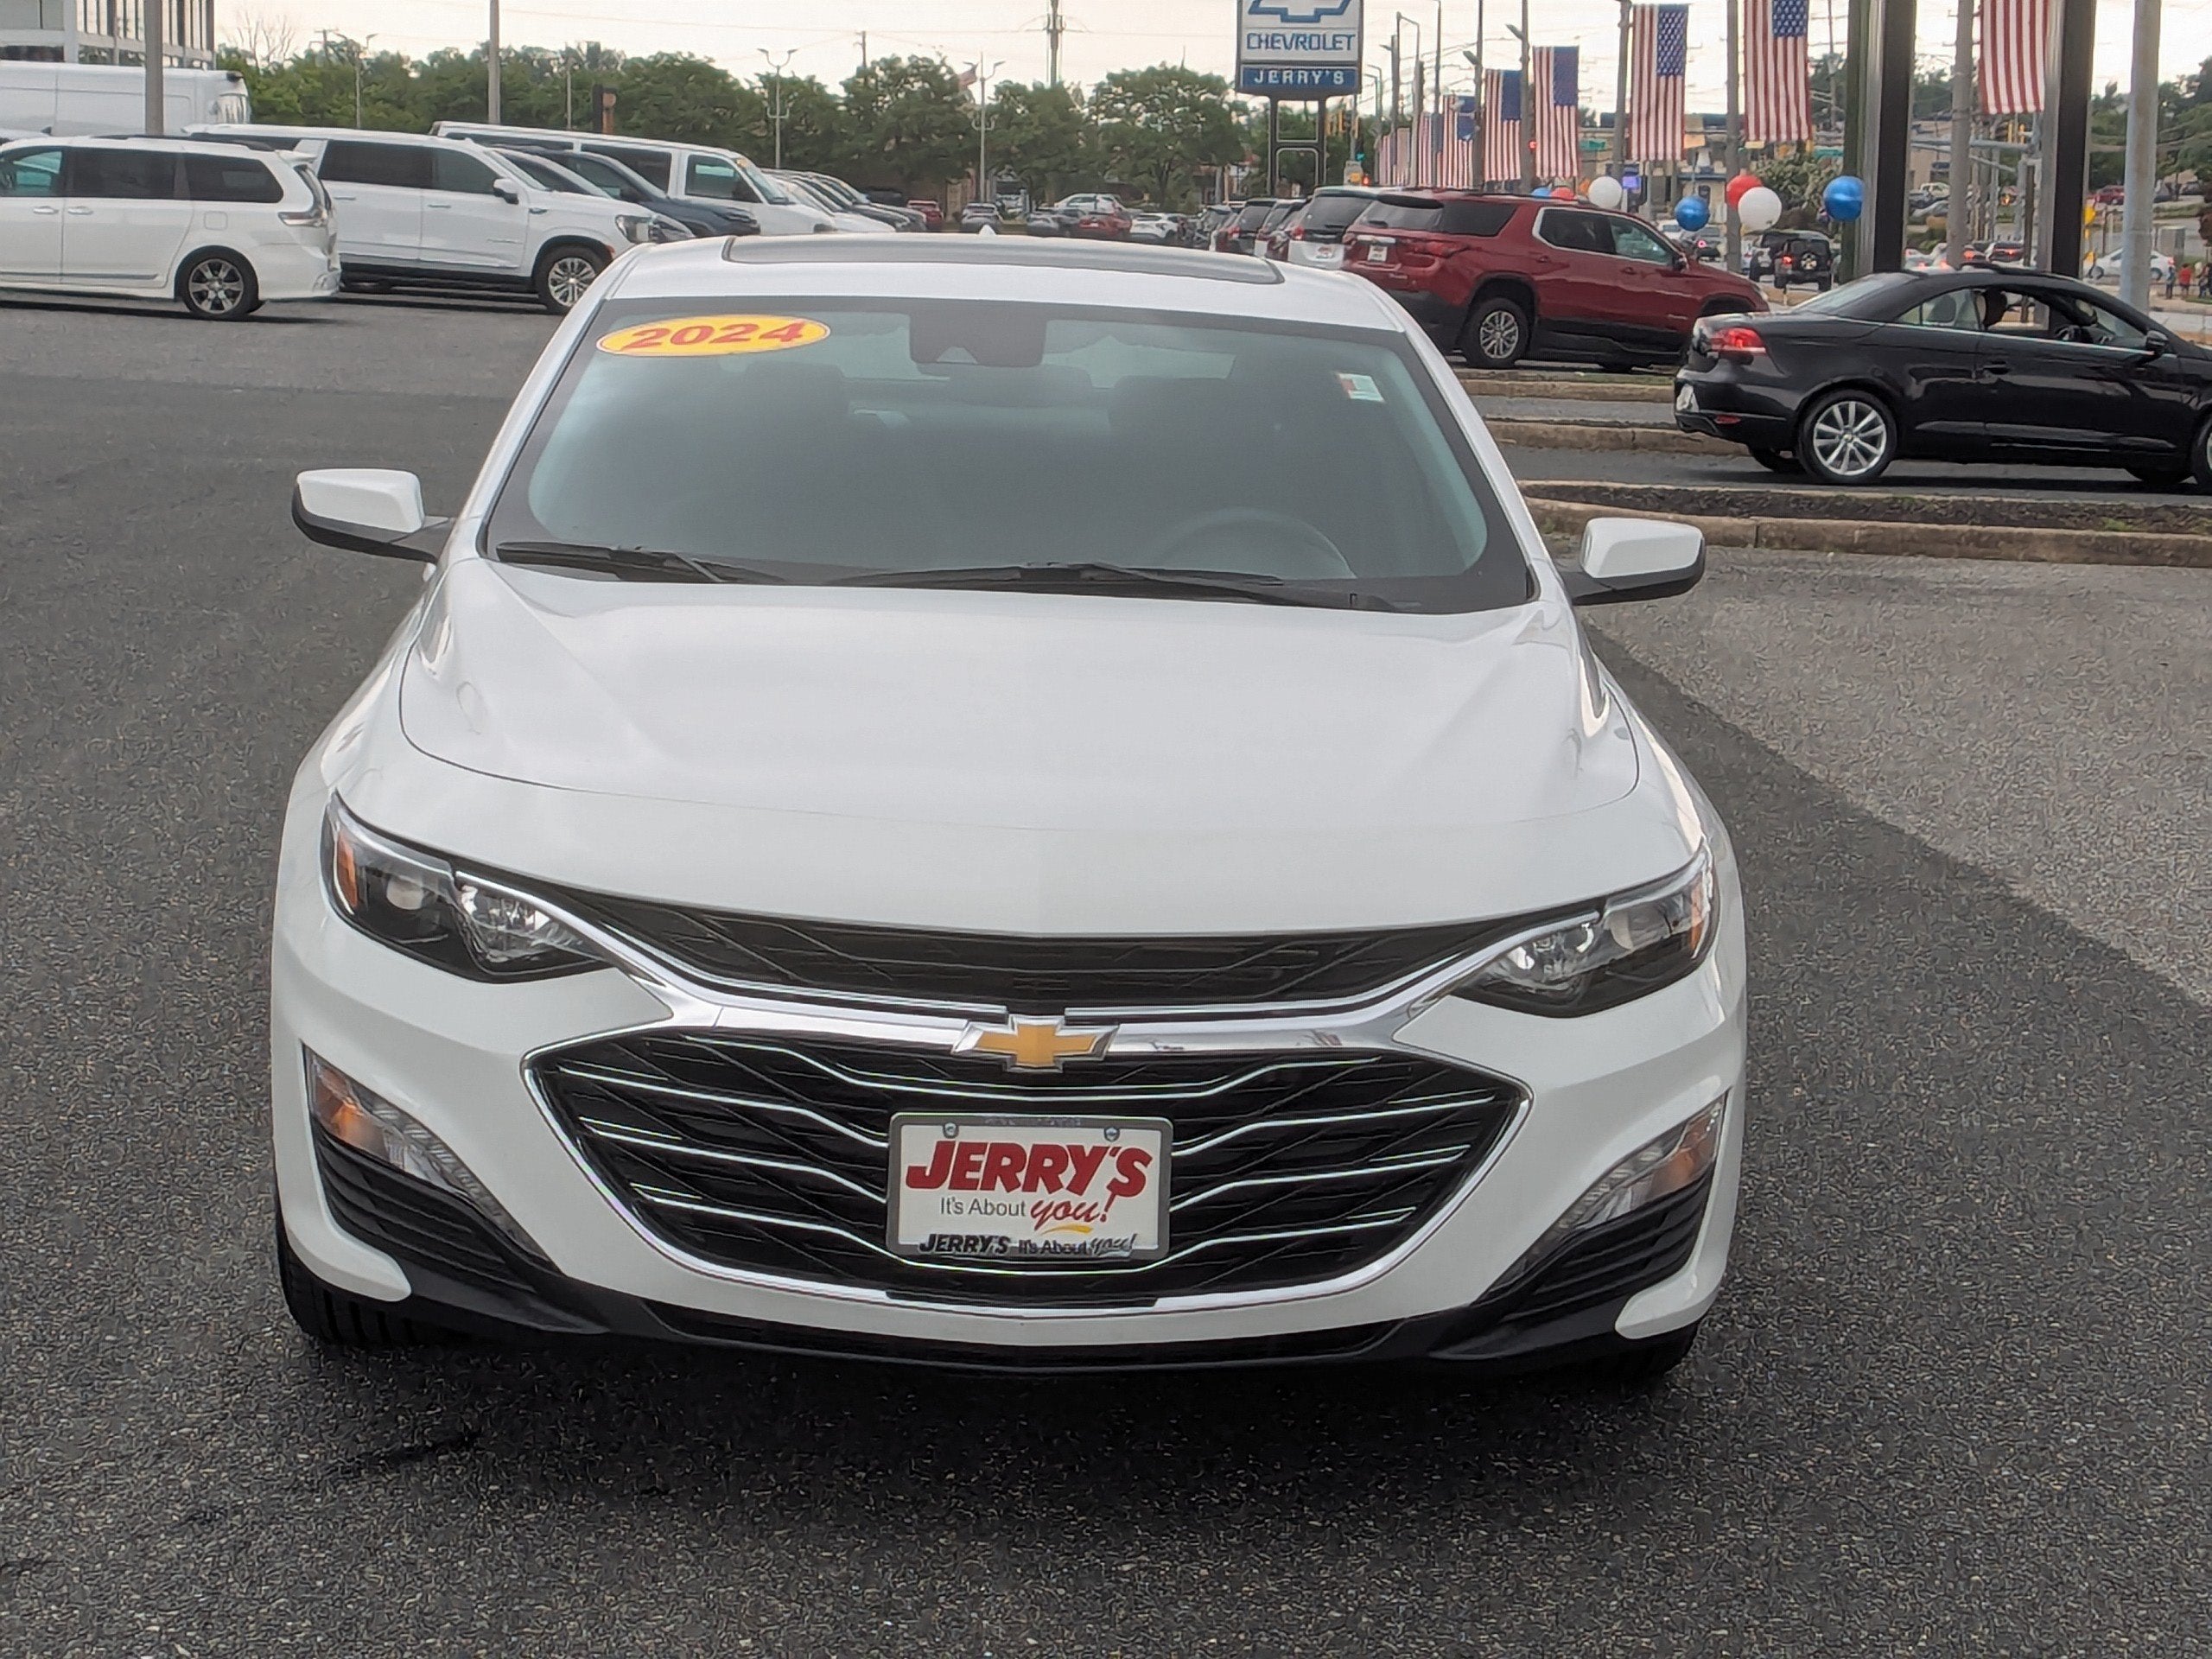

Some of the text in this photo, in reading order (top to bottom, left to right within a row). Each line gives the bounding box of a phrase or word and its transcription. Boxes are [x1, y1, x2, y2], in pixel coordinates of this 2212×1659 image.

[1247, 32, 1356, 51] CHEVROLET
[1254, 68, 1344, 86] JERRY'S
[620, 322, 805, 352] 2024
[906, 1140, 1153, 1198] JERRY'S
[940, 1193, 1116, 1231] It's About you!
[919, 1233, 1012, 1254] JERRY'S
